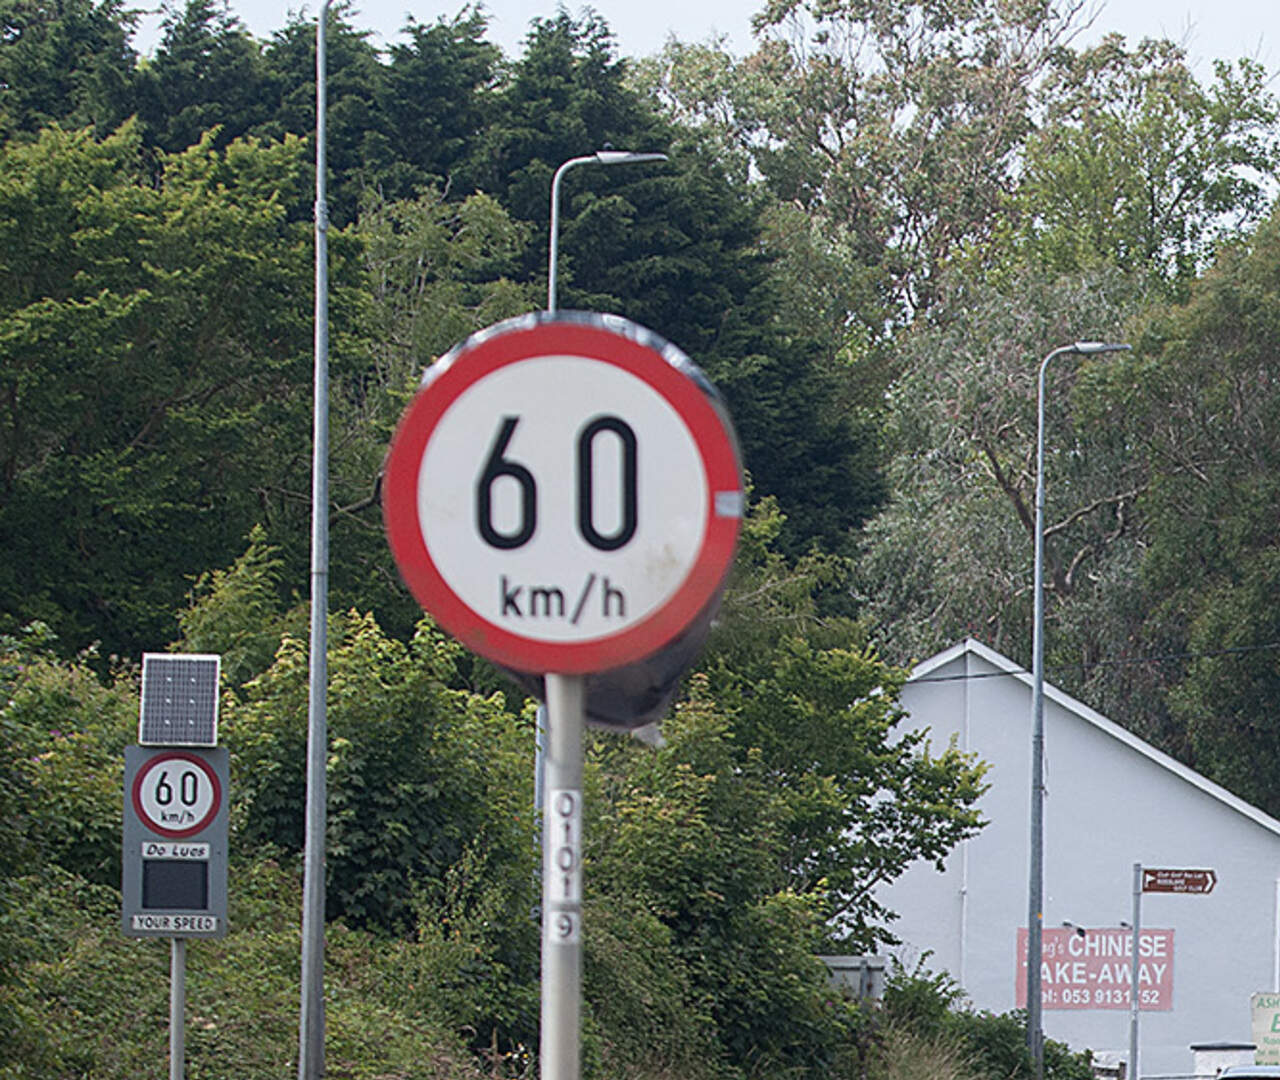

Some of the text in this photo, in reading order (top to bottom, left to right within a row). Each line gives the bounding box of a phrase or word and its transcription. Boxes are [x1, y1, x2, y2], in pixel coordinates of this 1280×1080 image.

[476, 414, 638, 551] 60
[500, 573, 627, 626] km/h
[155, 770, 199, 806] 60
[160, 810, 196, 824] km/h
[137, 916, 213, 930] YOUR SPEED
[1068, 932, 1167, 957] CHINESE
[1023, 961, 1167, 985] AKE-AWAY
[1062, 987, 1091, 1004] 053
[1094, 988, 1160, 1005] 913152
